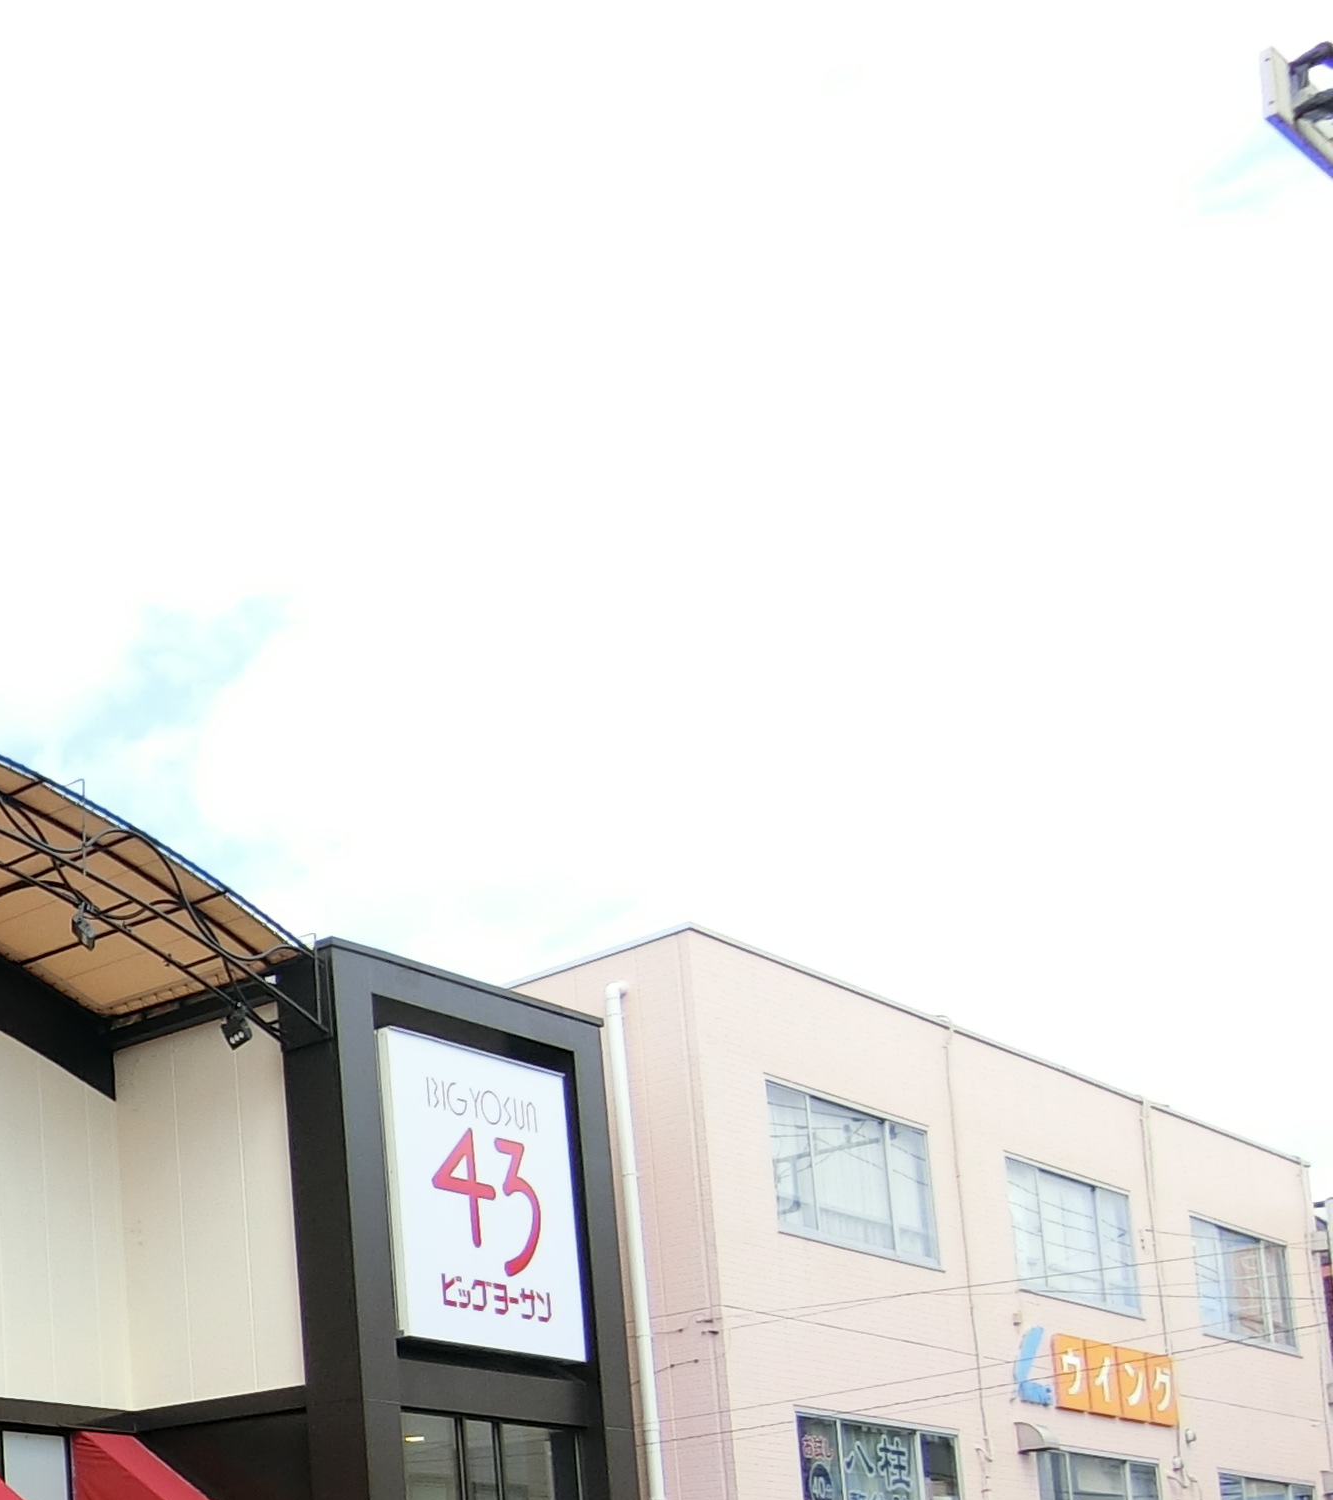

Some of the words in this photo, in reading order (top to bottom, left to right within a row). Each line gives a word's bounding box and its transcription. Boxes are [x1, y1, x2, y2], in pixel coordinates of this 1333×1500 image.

[431, 1127, 542, 1277] 43
[441, 1272, 552, 1323] ビッグヨーサン
